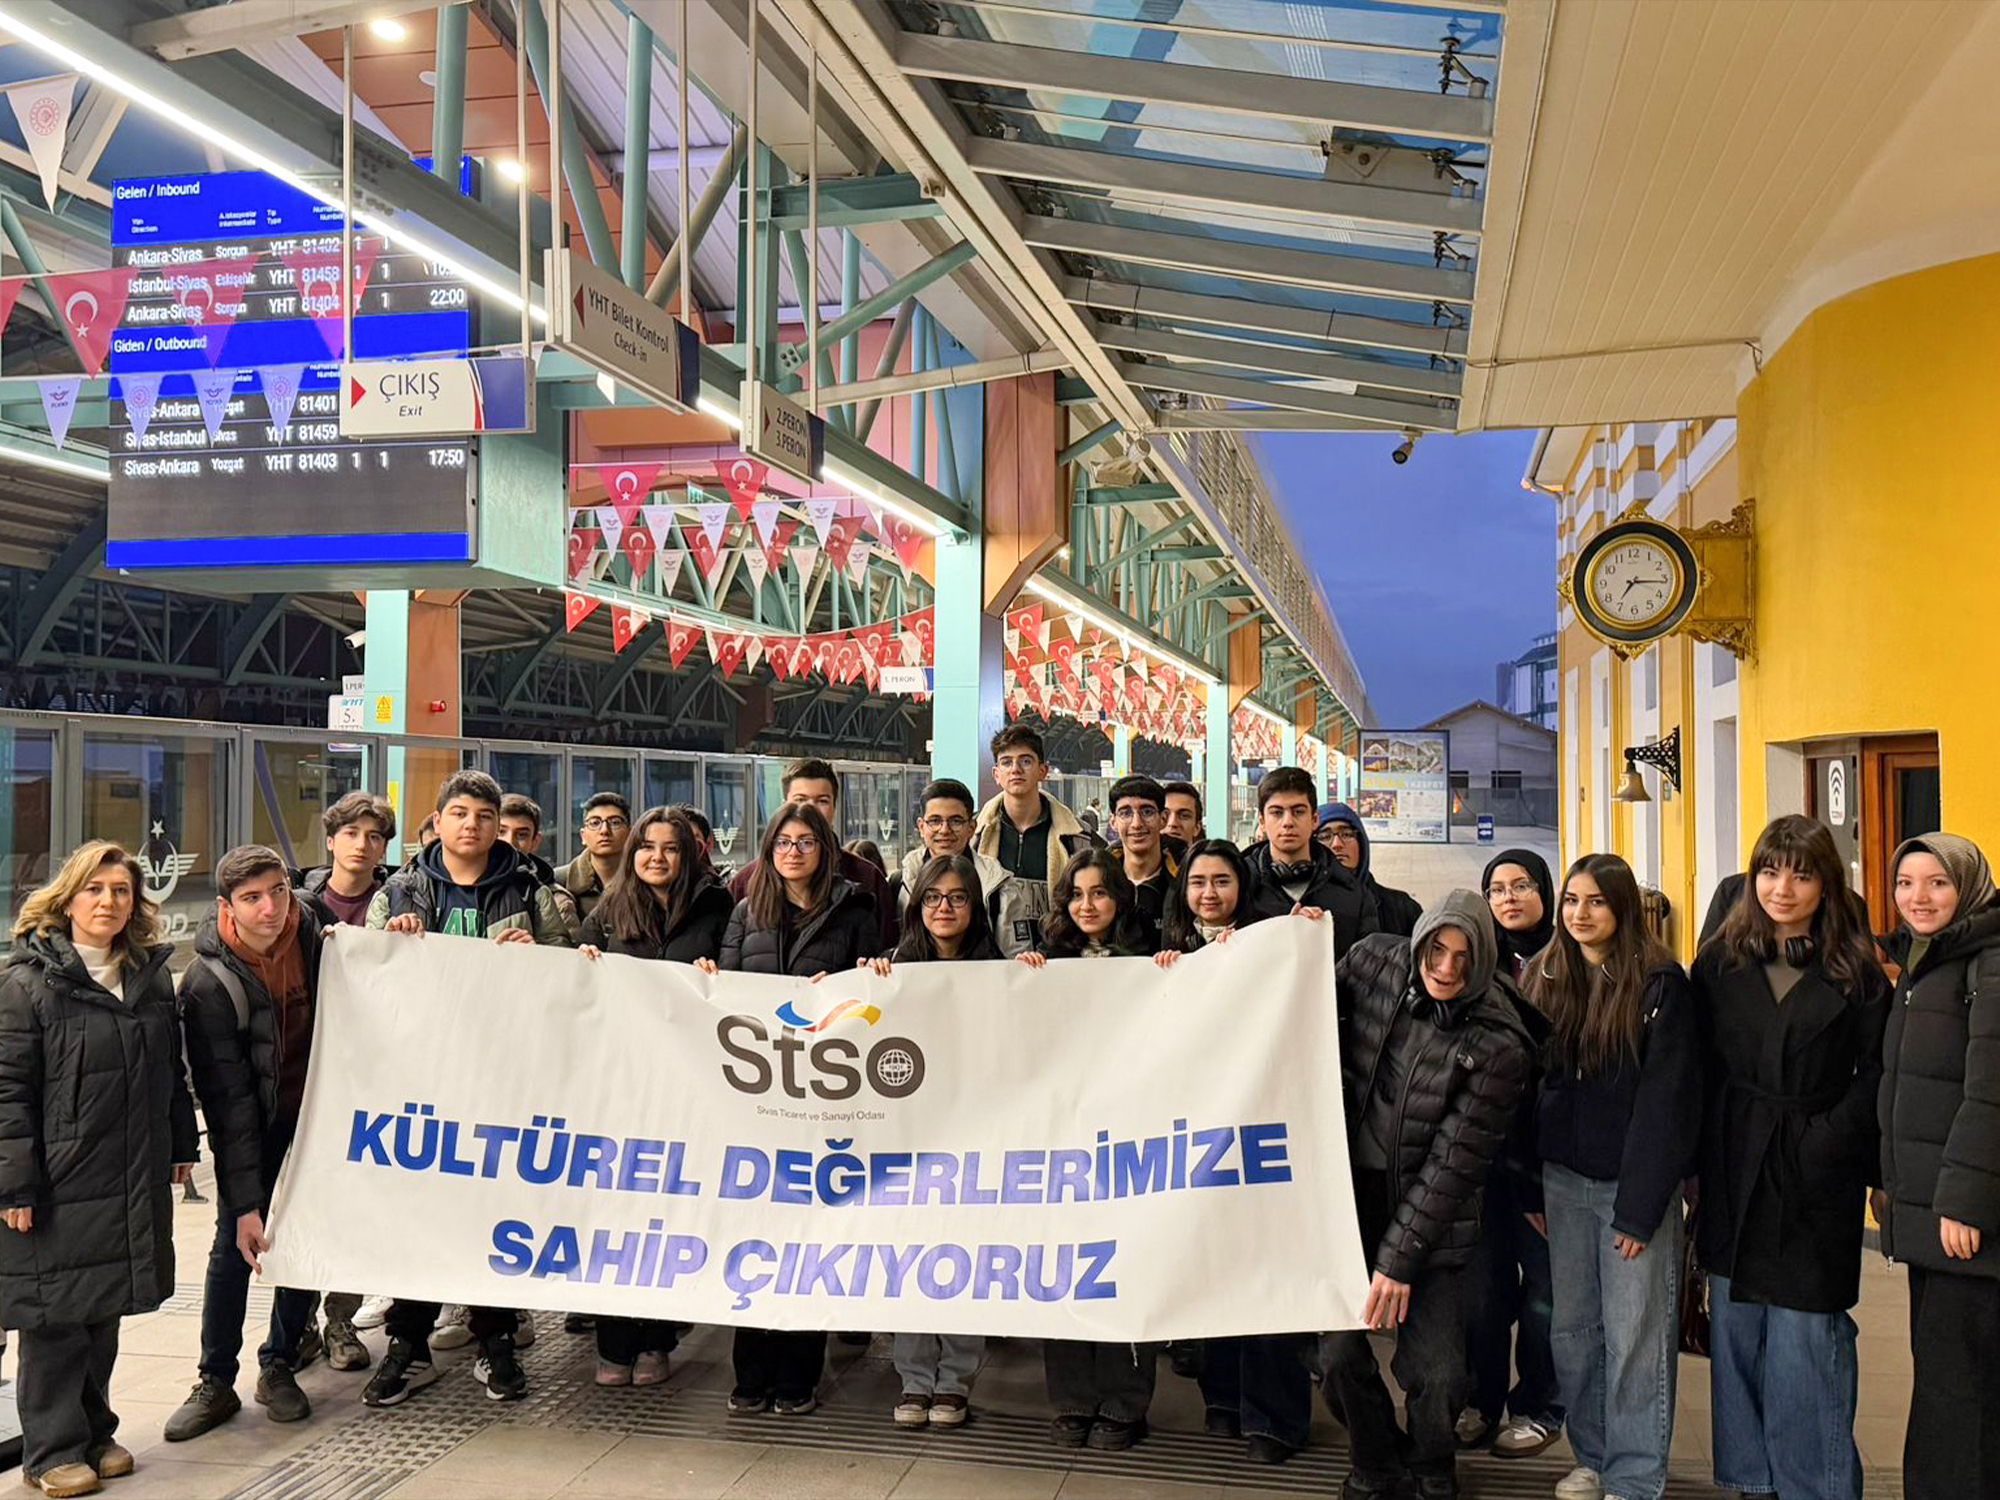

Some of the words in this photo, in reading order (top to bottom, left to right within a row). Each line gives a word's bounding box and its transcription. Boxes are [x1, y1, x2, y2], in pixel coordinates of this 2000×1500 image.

[117, 187, 147, 200] Gelen
[149, 184, 154, 198] /
[157, 182, 200, 197] Inbound
[267, 217, 282, 225] Type
[131, 225, 158, 233] Direction
[128, 247, 203, 266] Ankara-Sivas
[216, 245, 248, 260] Sorgun
[270, 240, 297, 257] YHT
[302, 237, 340, 255] 81402
[354, 236, 362, 251] 1
[269, 269, 296, 285] YHT
[302, 267, 340, 283] 81458
[354, 264, 362, 279] 1
[381, 263, 390, 279] 1
[127, 304, 203, 322] Ankara-Sivas
[215, 302, 247, 316] Sorgun
[268, 297, 296, 314] YHT
[302, 295, 340, 312] 81404
[381, 292, 390, 308] 1
[430, 288, 465, 306] 22:00
[588, 287, 610, 315] YHT
[611, 302, 634, 334] Bilet
[636, 318, 669, 353] Kontrol
[114, 339, 145, 353] Giden
[146, 338, 152, 352] /
[154, 335, 207, 351] Outbound
[614, 332, 648, 363] Check-in
[379, 371, 441, 403] ÇIKIŞ
[299, 395, 337, 411] 81401
[399, 405, 423, 417] Exit
[299, 424, 338, 441] 81459
[125, 458, 199, 476] Sivas-Ankara
[211, 457, 243, 472] Yozgat
[265, 455, 293, 471] YHT
[299, 453, 337, 469] 81403
[352, 453, 360, 468] 1
[379, 452, 388, 467] 1
[429, 449, 464, 466] 17:50
[1615, 554, 1623, 564] 11
[1628, 548, 1640, 558] 12
[1604, 565, 1616, 575] 10
[1655, 561, 1662, 571] 2
[1599, 579, 1607, 589] 9
[1661, 574, 1668, 584] 3
[1604, 593, 1612, 603] 8
[1655, 590, 1663, 599] 4
[1617, 602, 1623, 612] 7
[1631, 605, 1639, 615] 6
[1646, 600, 1655, 610] 5
[343, 708, 355, 723] 5.
[717, 1014, 926, 1101] Stso
[756, 1105, 778, 1117] Sivas
[780, 1108, 807, 1121] Ticaret
[809, 1113, 819, 1121] ve
[821, 1111, 855, 1123] Sanayi
[856, 1110, 885, 1121] Odası
[347, 1102, 701, 1196] KÜLTÜREL
[718, 1118, 1292, 1207] DEĞERLERİMİZE
[488, 1218, 708, 1288] SAHİP
[723, 1239, 1117, 1310] ÇIKIYORUZ
